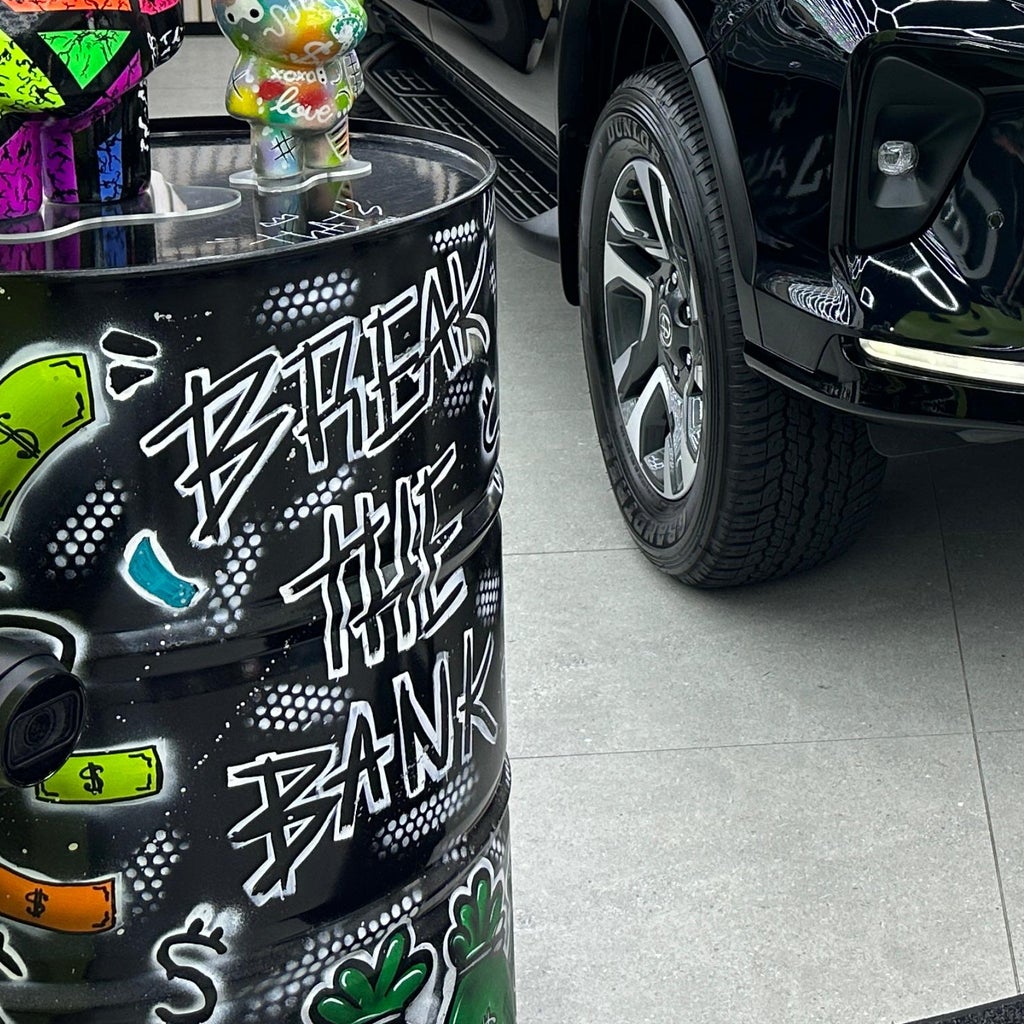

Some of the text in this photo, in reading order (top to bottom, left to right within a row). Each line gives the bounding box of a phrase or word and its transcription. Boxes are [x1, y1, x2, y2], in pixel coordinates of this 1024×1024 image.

[270, 86, 333, 122] love
[139, 243, 491, 547] BREAK
[278, 442, 469, 679] THE
[227, 628, 499, 906] BANK
